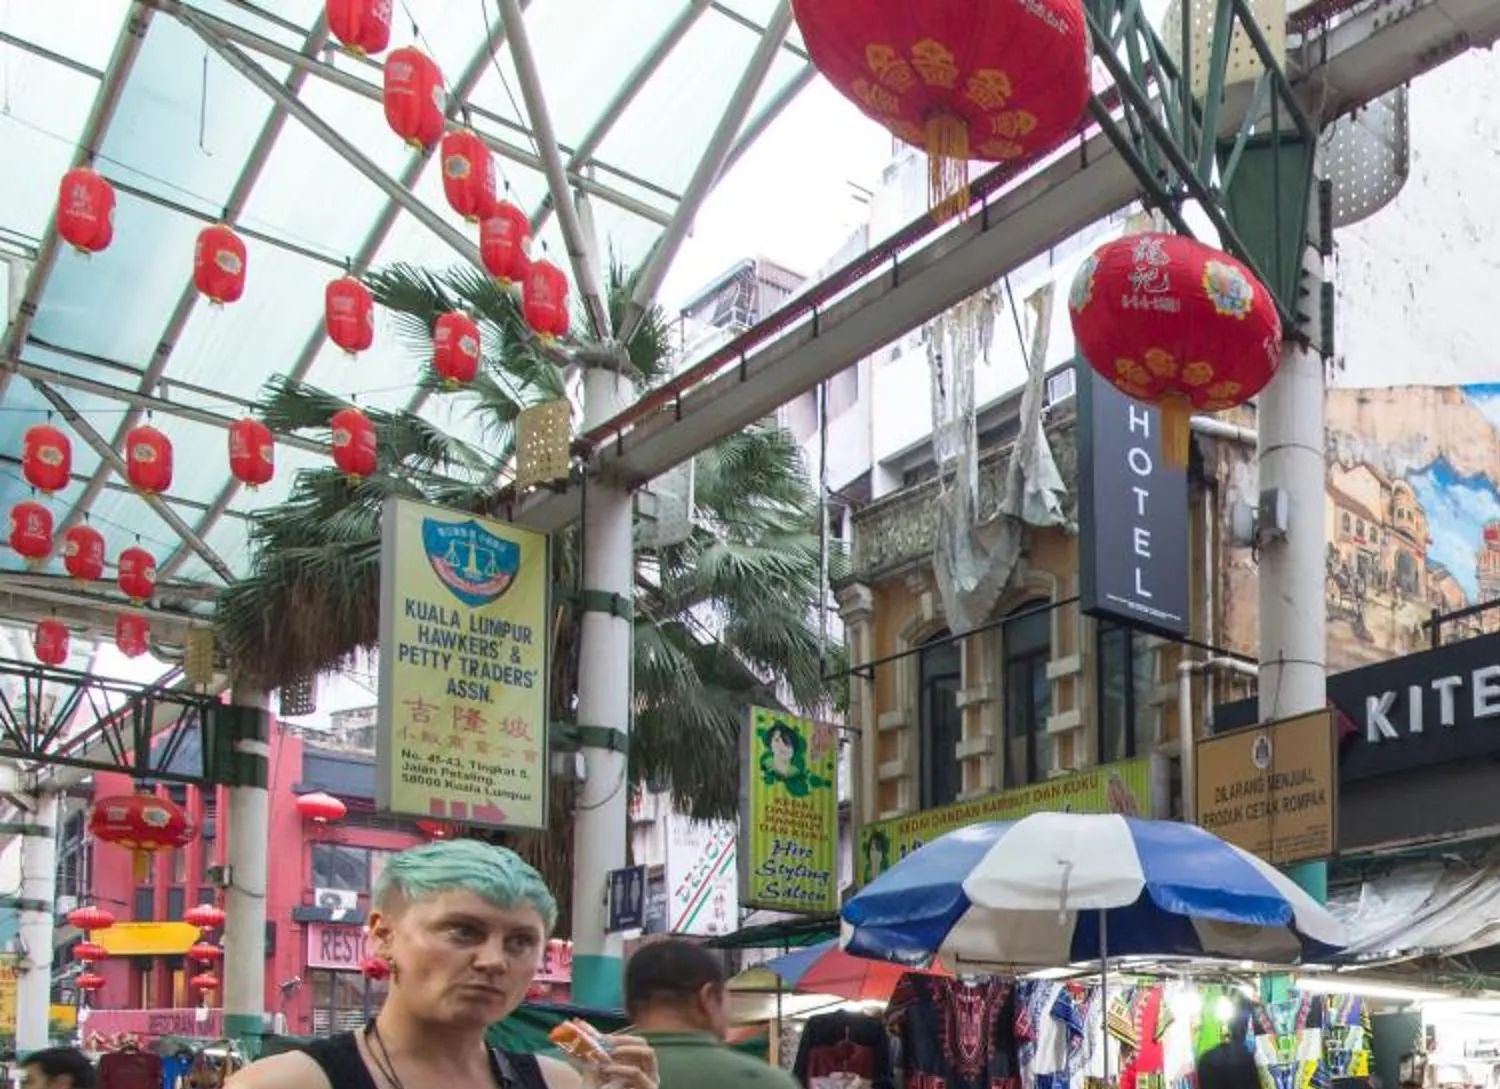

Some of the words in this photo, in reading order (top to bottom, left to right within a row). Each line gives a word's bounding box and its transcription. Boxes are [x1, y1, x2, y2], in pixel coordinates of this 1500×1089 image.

[1127, 404, 1153, 598] HOTEL
[405, 597, 460, 629] KUALA
[469, 613, 532, 644] LUMPUR
[398, 642, 452, 672] PETTY
[511, 645, 521, 665] &
[446, 677, 495, 704] ASSN.
[401, 762, 437, 775] Jalan
[445, 779, 481, 794] Kuala
[484, 787, 532, 801] Lumpur
[1033, 785, 1061, 802] DAN
[1063, 775, 1099, 796] KUKU
